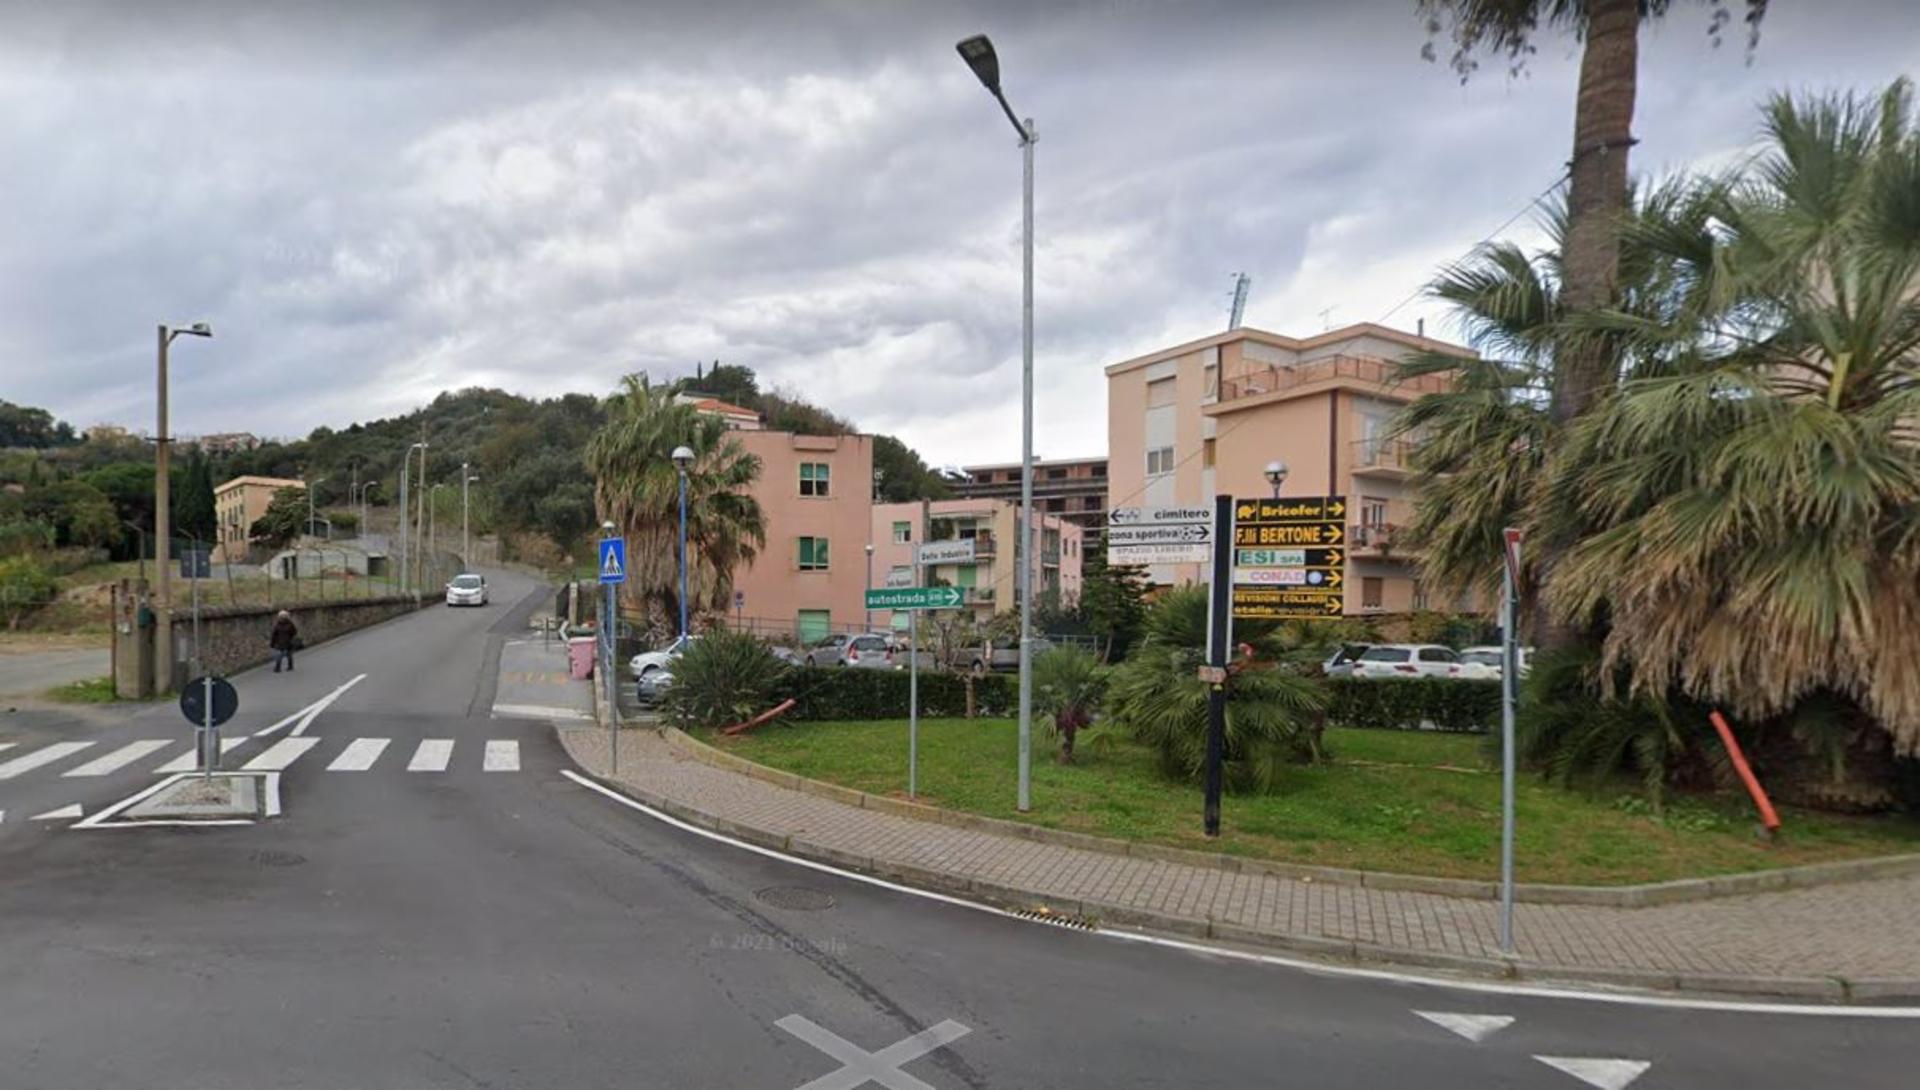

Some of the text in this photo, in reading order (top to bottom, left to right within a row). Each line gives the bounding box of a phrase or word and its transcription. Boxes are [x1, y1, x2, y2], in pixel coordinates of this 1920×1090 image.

[1154, 509, 1210, 520] cimitero
[1261, 505, 1321, 516] Bricofer
[1135, 529, 1179, 541] sportiva
[1260, 526, 1322, 543] BERTONE
[1239, 551, 1276, 564] ESI
[1249, 570, 1305, 582] CONAD
[867, 593, 926, 605] autostrada
